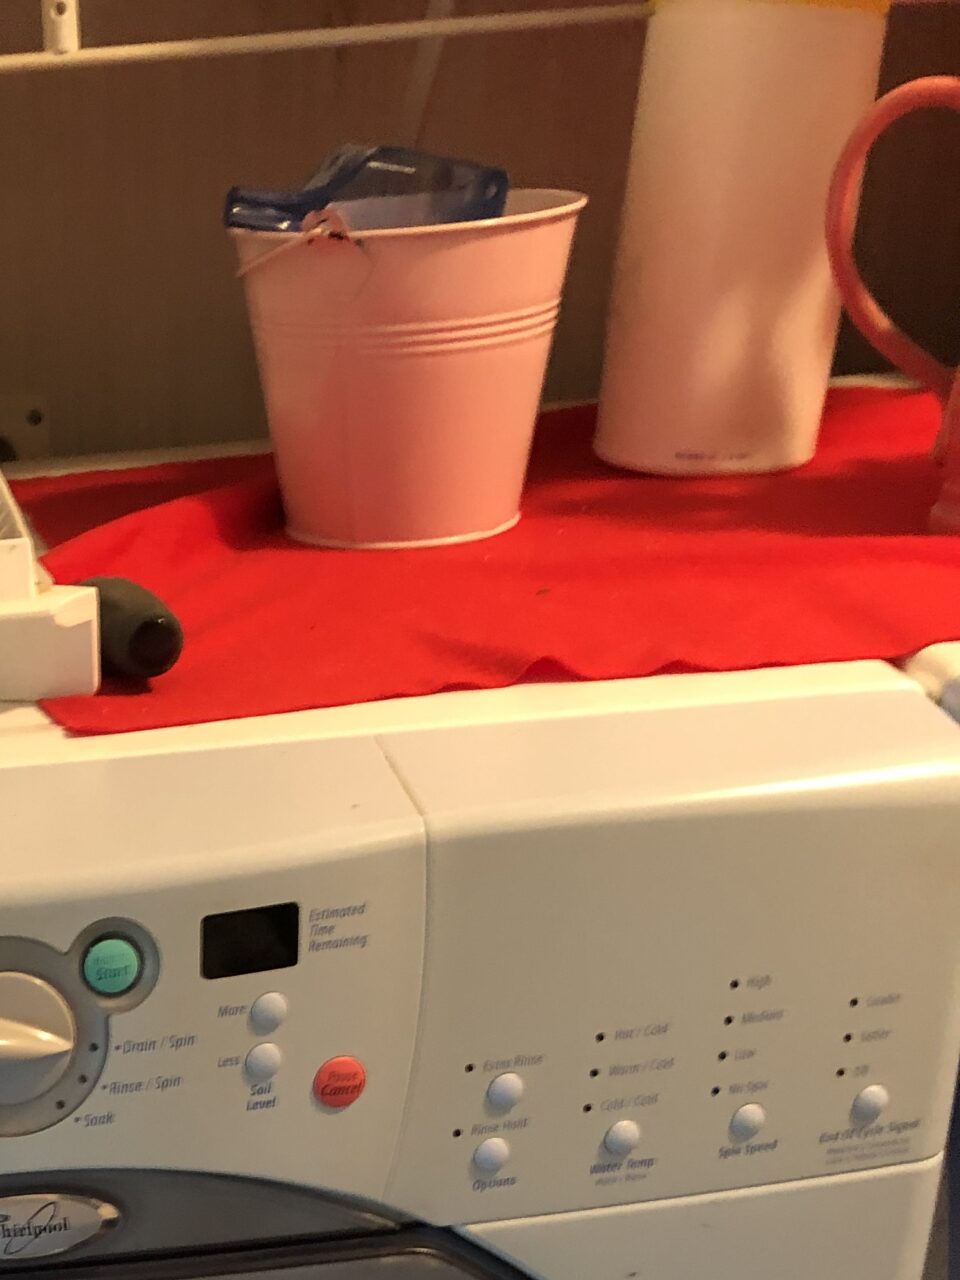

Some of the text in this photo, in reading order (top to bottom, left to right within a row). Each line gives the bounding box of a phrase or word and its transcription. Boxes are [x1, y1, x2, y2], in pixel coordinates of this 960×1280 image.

[309, 903, 367, 922] Estimated
[309, 923, 336, 936] Time
[308, 934, 368, 953] Remaining
[96, 965, 132, 981] Start
[217, 1003, 247, 1018] More
[122, 1038, 157, 1054] Drain
[168, 1033, 196, 1050] Spin
[108, 1081, 143, 1096] Rinse
[155, 1075, 183, 1092] Spin
[249, 1081, 272, 1097] Soil
[246, 1097, 277, 1112] Level
